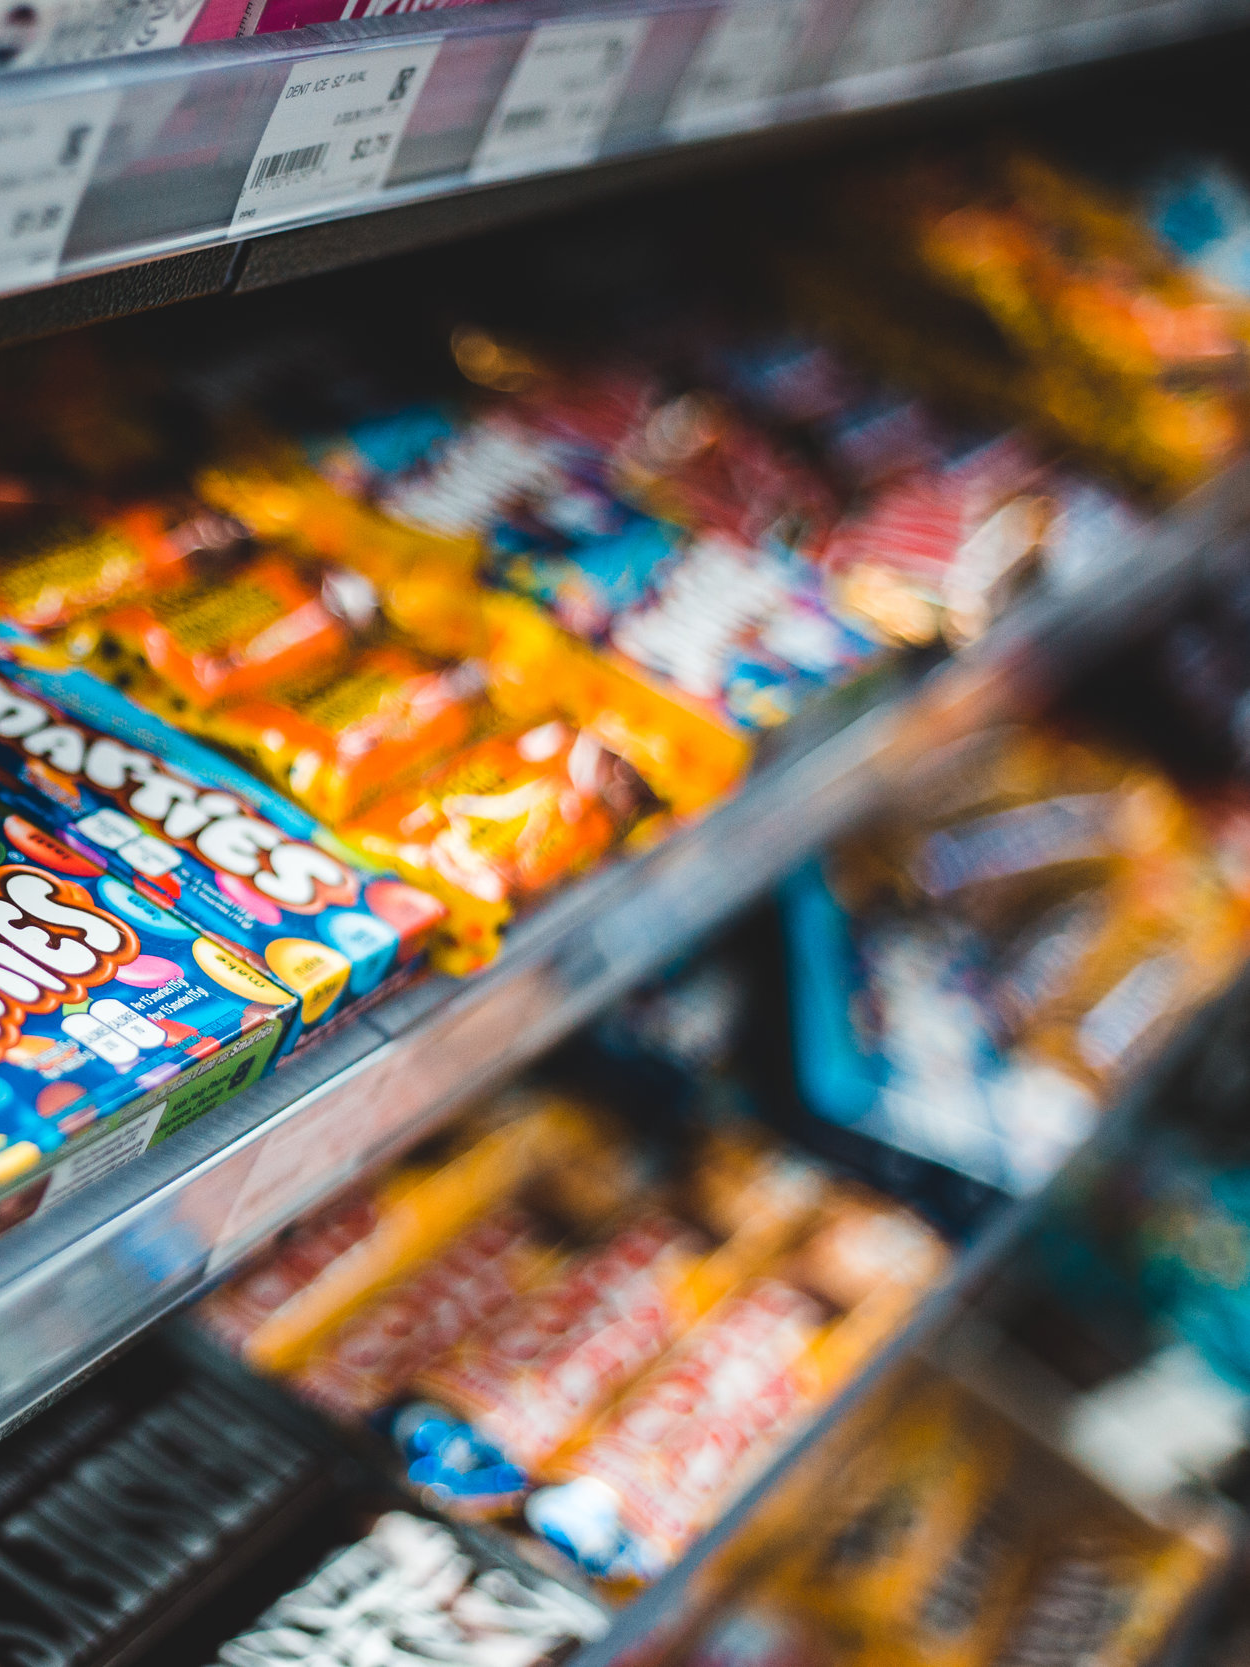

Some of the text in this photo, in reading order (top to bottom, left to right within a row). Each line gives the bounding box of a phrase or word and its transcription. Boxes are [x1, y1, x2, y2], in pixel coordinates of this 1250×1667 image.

[284, 83, 312, 100] DENT
[213, 953, 268, 989] make
[130, 1001, 146, 1011] Per
[150, 984, 176, 1006] Smarties
[146, 1009, 167, 1022] Pour
[170, 993, 196, 1014] Smarties
